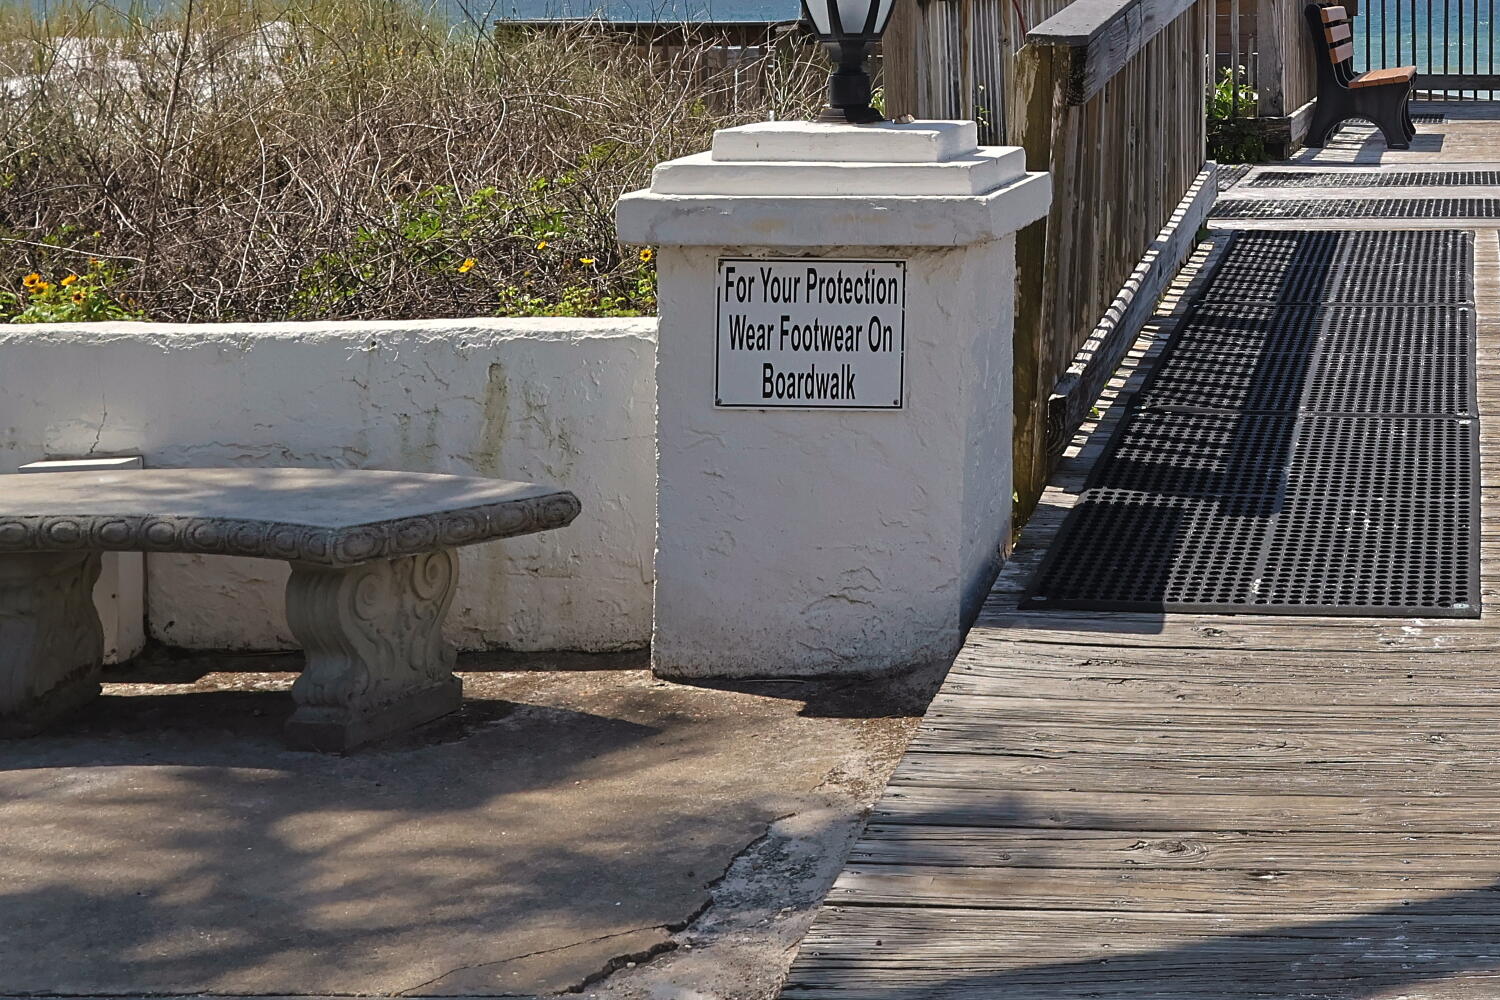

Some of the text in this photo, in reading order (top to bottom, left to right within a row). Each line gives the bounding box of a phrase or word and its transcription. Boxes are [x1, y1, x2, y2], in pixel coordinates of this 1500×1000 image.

[725, 266, 898, 305] For Your Protection
[729, 314, 893, 353] Wear Footwear On
[762, 362, 856, 400] Boardwalk
